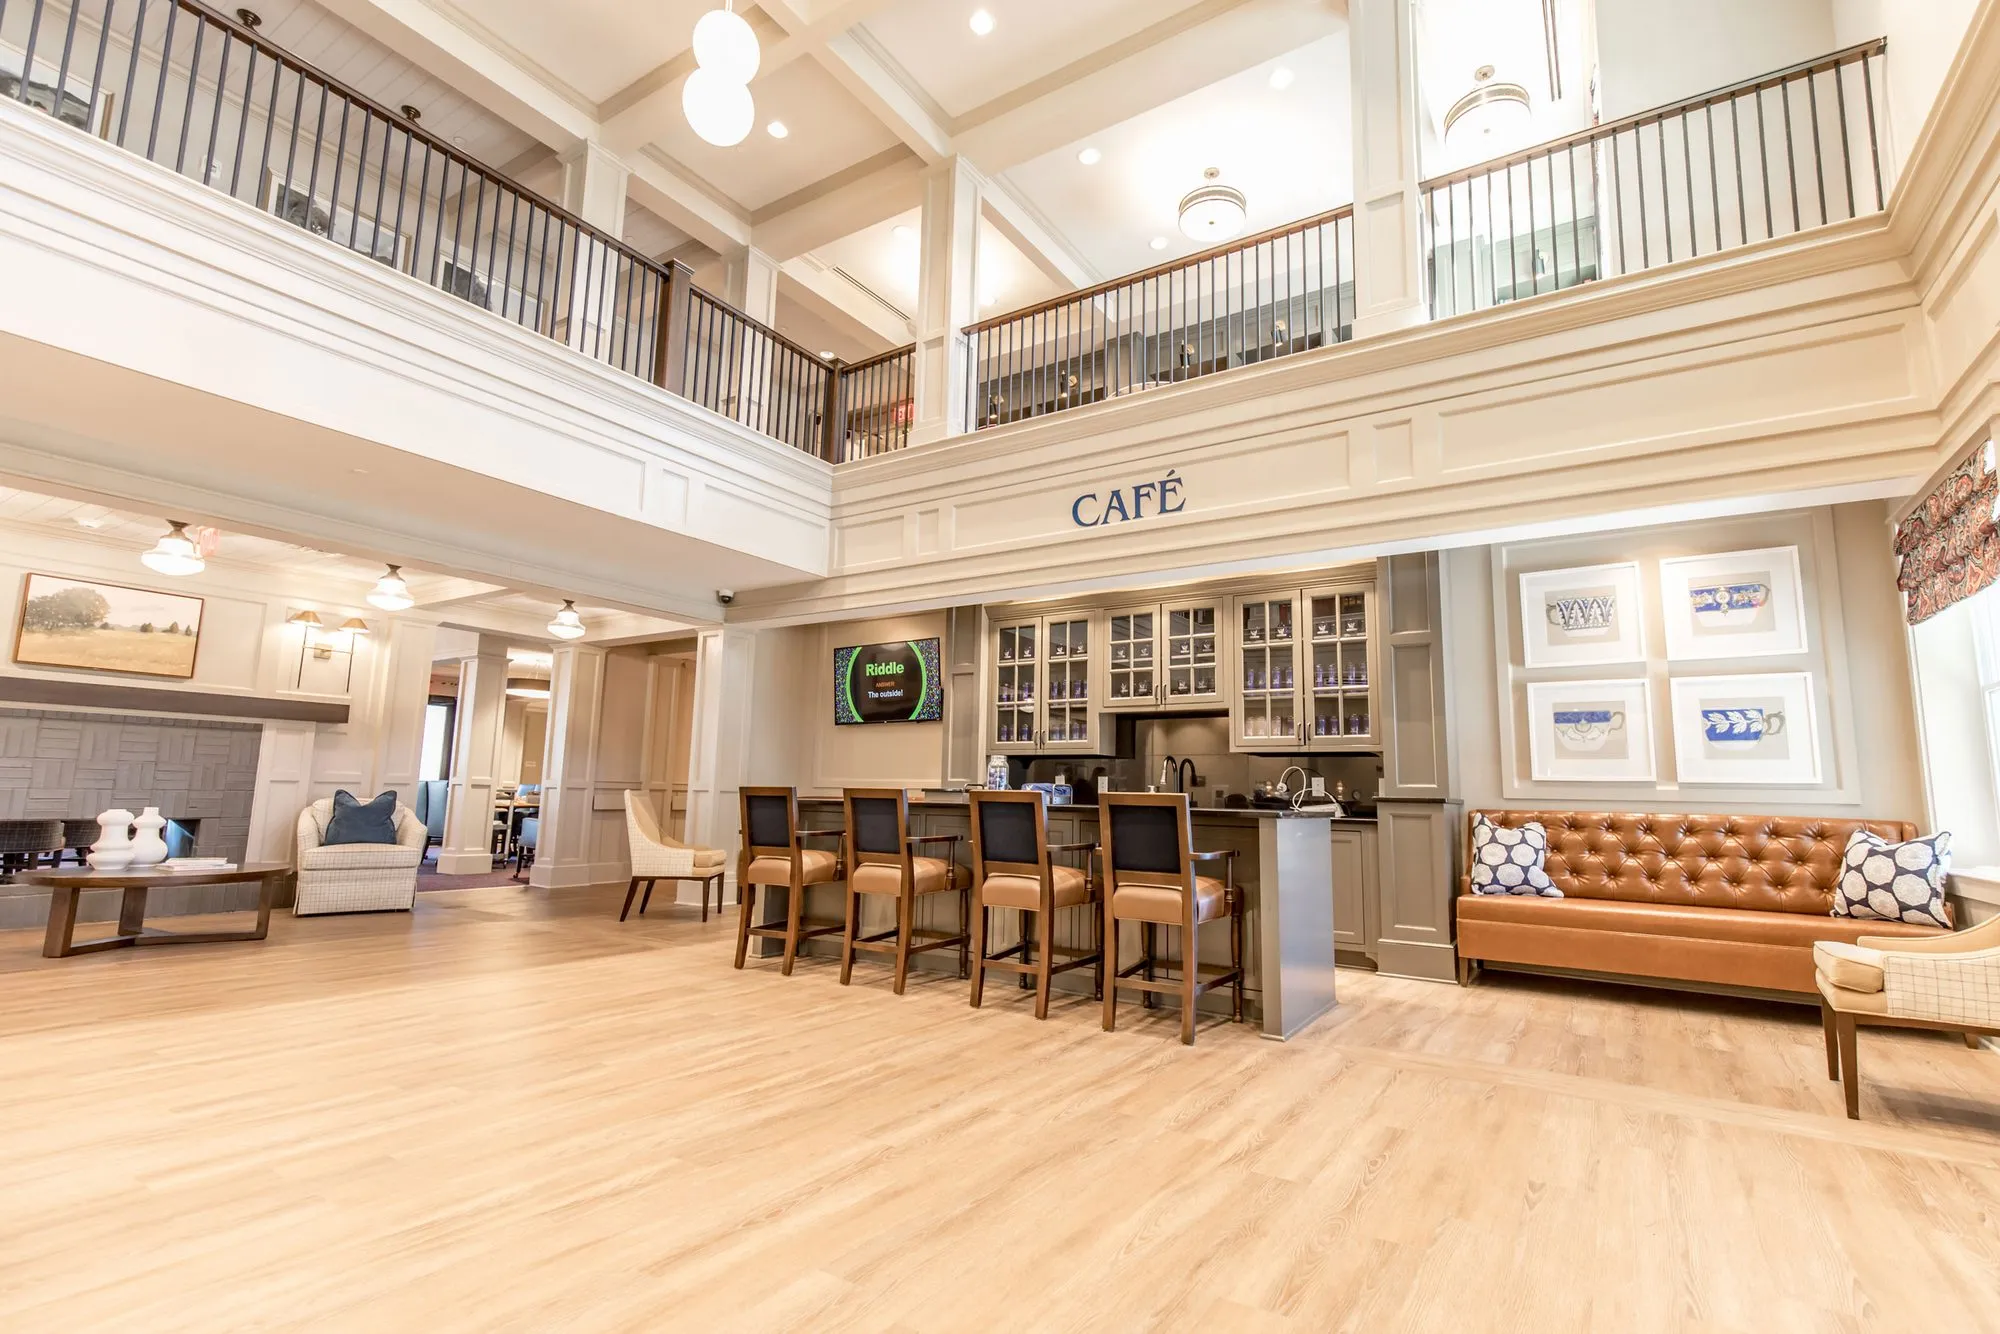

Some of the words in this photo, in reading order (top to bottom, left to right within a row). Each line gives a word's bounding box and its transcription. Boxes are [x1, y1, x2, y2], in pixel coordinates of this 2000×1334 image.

[1072, 469, 1186, 527] CAFÉ
[865, 661, 905, 676] Riddle
[868, 691, 879, 699] The
[880, 689, 904, 698] outside!
